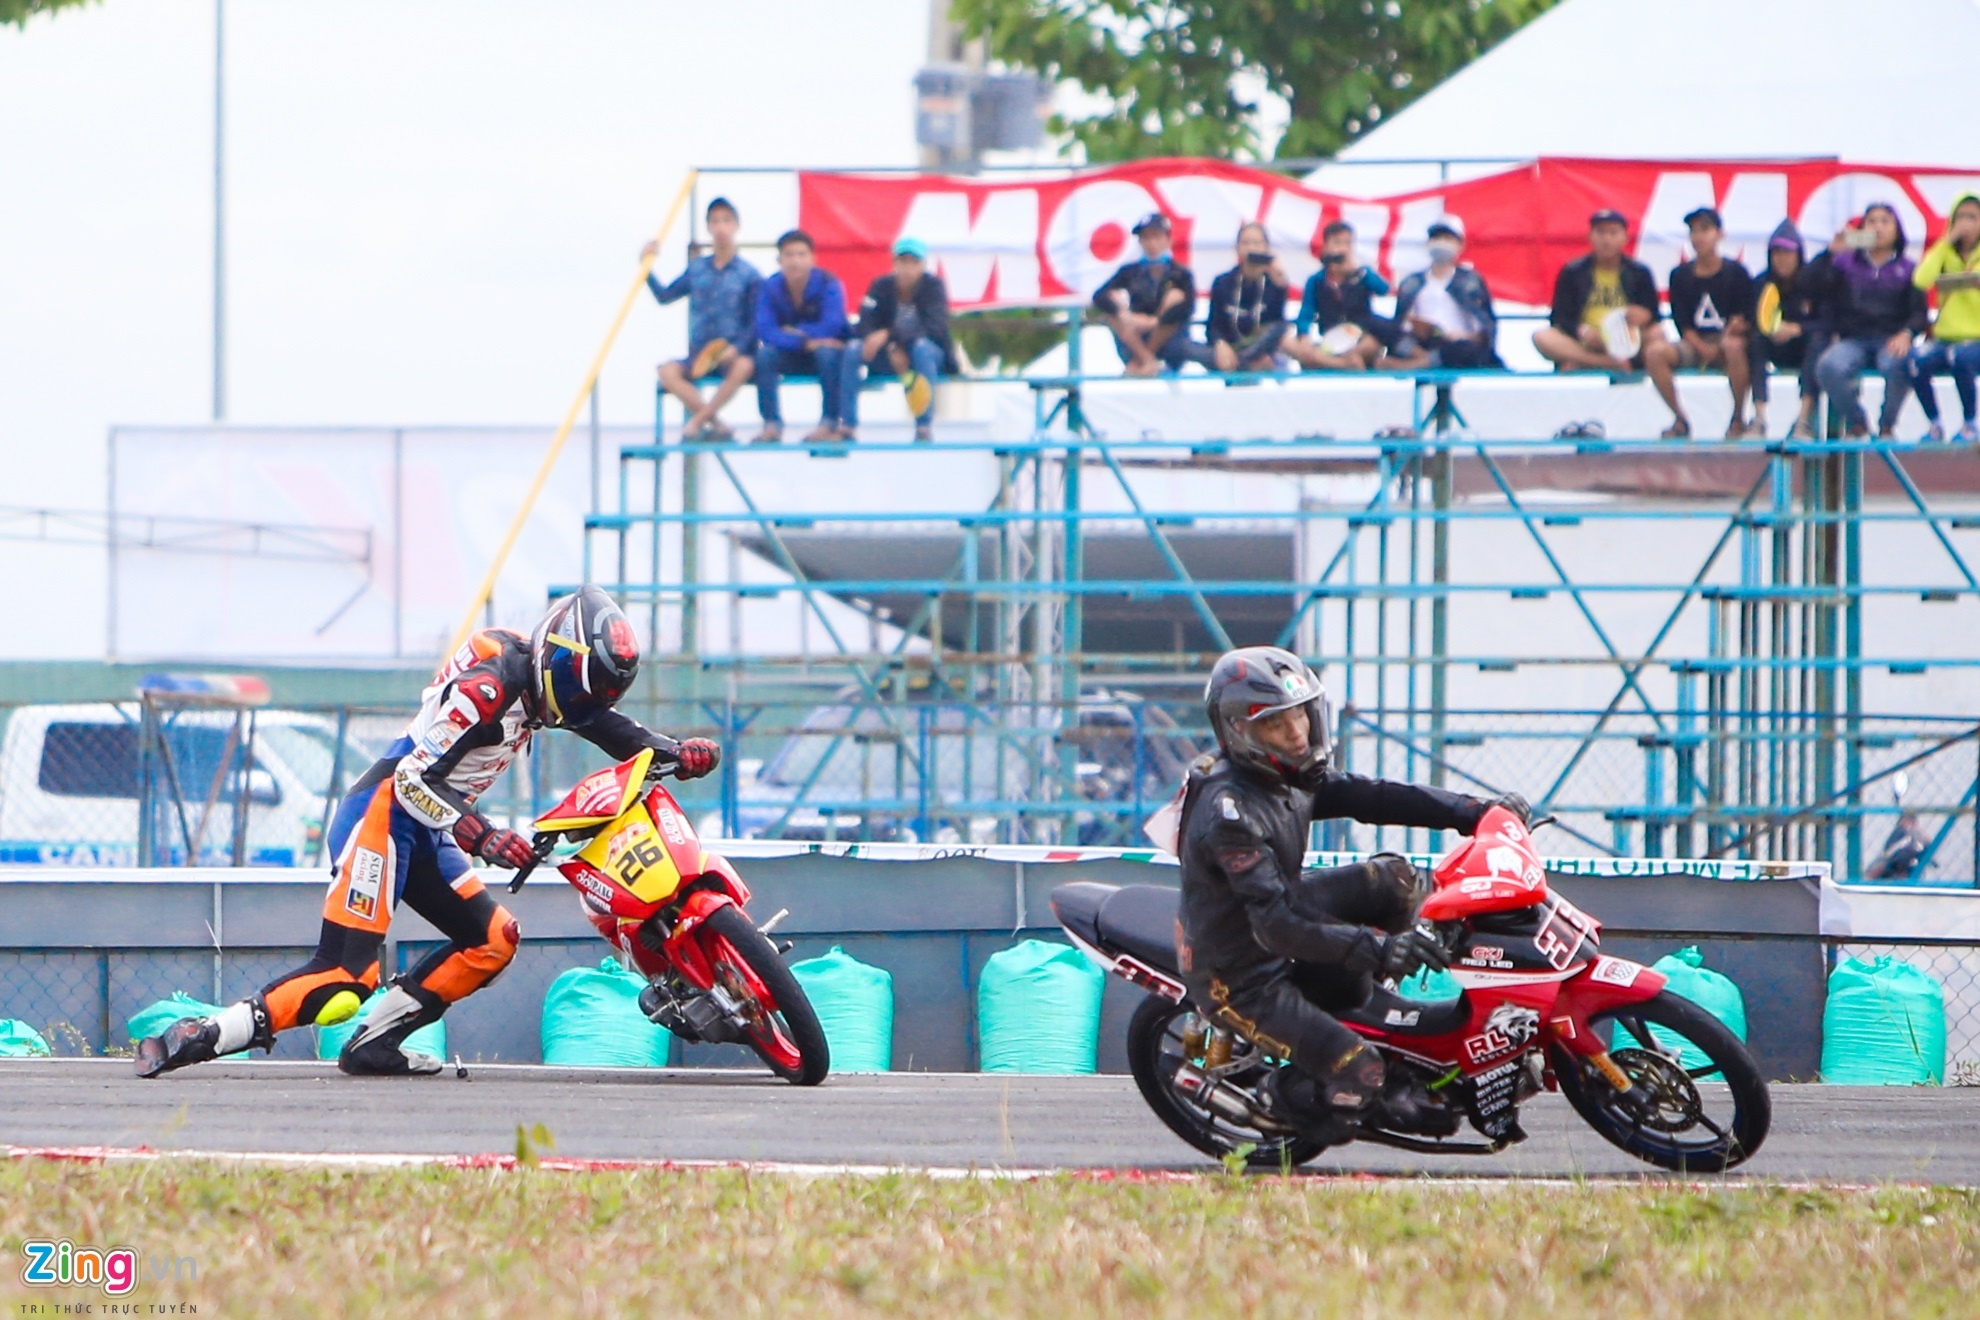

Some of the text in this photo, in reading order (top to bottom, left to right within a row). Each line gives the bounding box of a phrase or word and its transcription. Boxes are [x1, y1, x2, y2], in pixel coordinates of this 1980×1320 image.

[355, 852, 367, 882] racing
[368, 854, 380, 884] SUM
[615, 837, 664, 887] 26
[1465, 1030, 1511, 1060] RL
[1475, 1062, 1519, 1087] MOTUL
